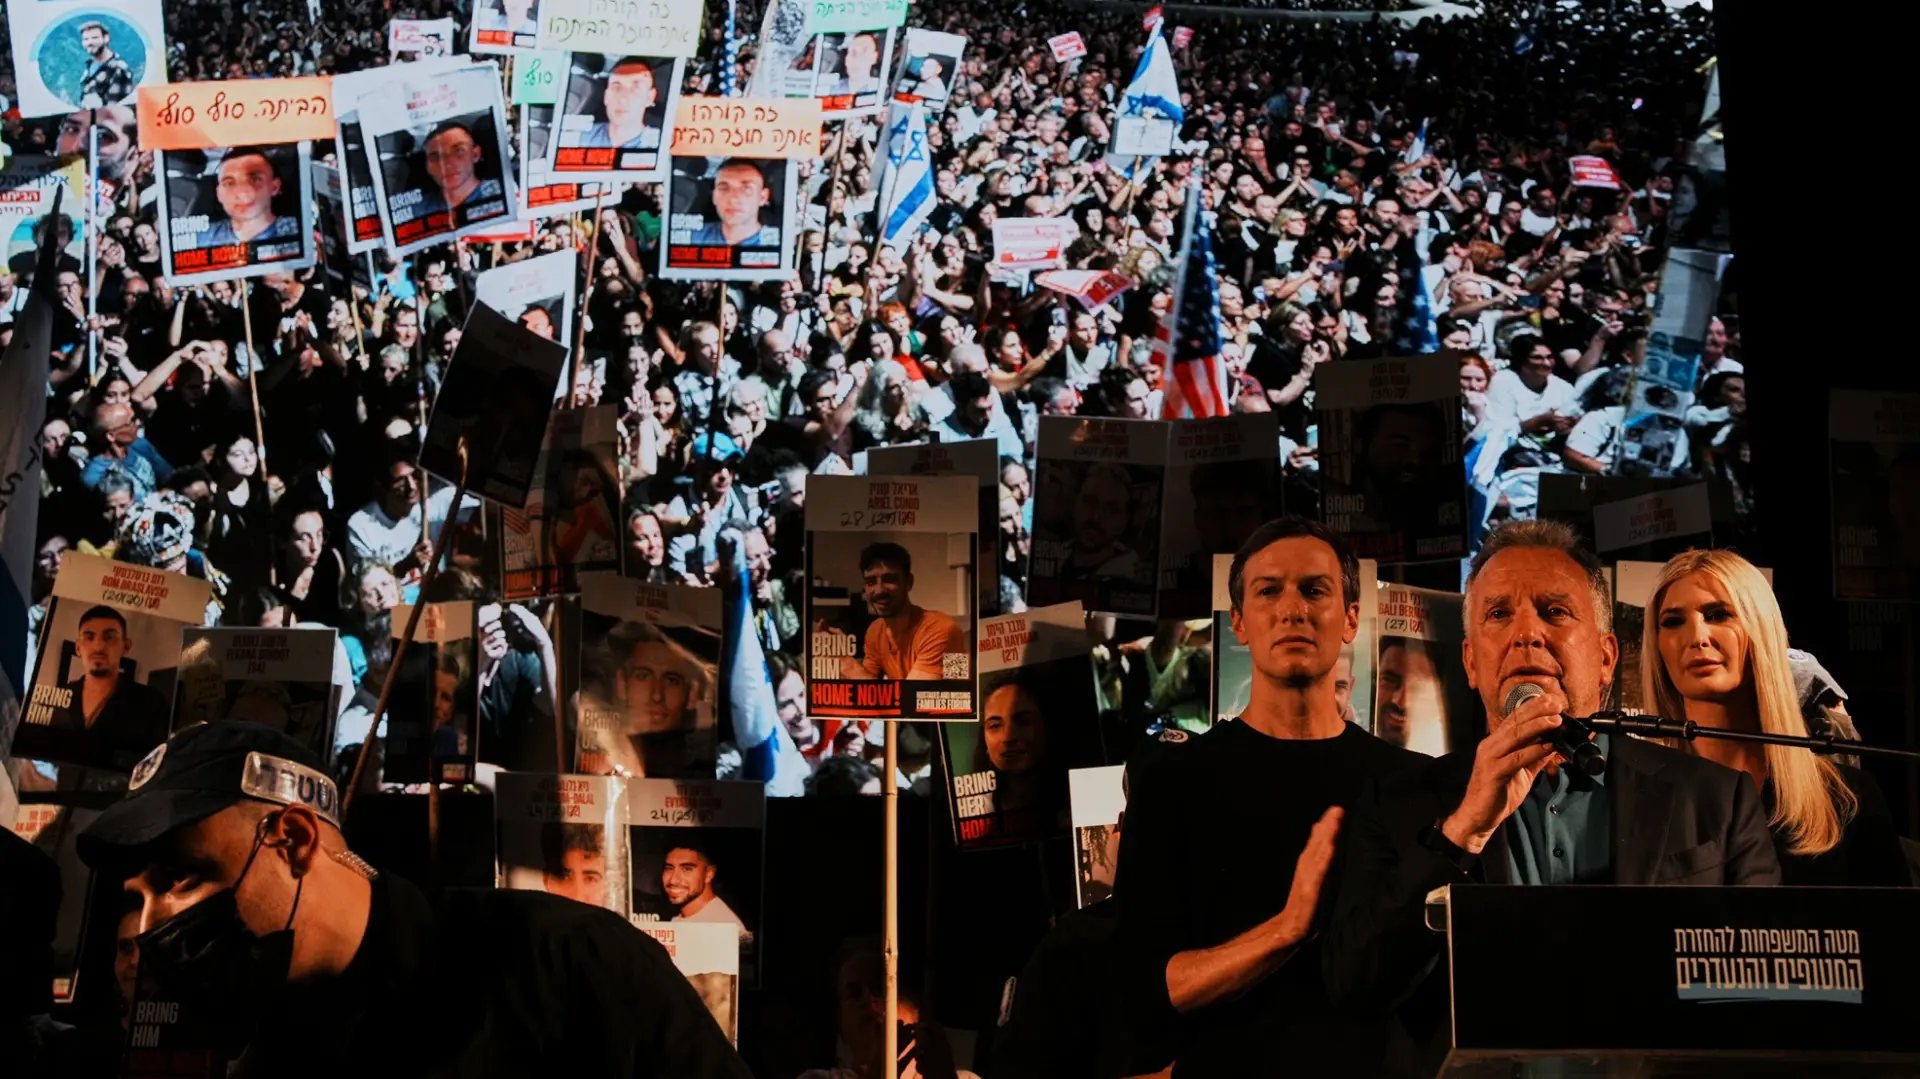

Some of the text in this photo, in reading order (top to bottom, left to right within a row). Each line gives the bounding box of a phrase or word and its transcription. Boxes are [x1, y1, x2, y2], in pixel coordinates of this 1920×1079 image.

[868, 497, 892, 510] ARIEL
[841, 511, 864, 526] 28
[811, 633, 857, 656] BRING
[811, 657, 840, 680] HIM
[33, 683, 73, 709] BRING
[811, 681, 901, 706] HOME NOW!
[26, 704, 55, 727] HIM
[954, 770, 996, 798] BRING
[650, 809, 668, 823] 24
[956, 793, 989, 819] HER
[1674, 926, 1860, 954] מטה המשפחות להחזרת
[1676, 957, 1864, 991] החטופים והנעדרים
[135, 1002, 180, 1025] BRING
[131, 1025, 161, 1048] HIM
